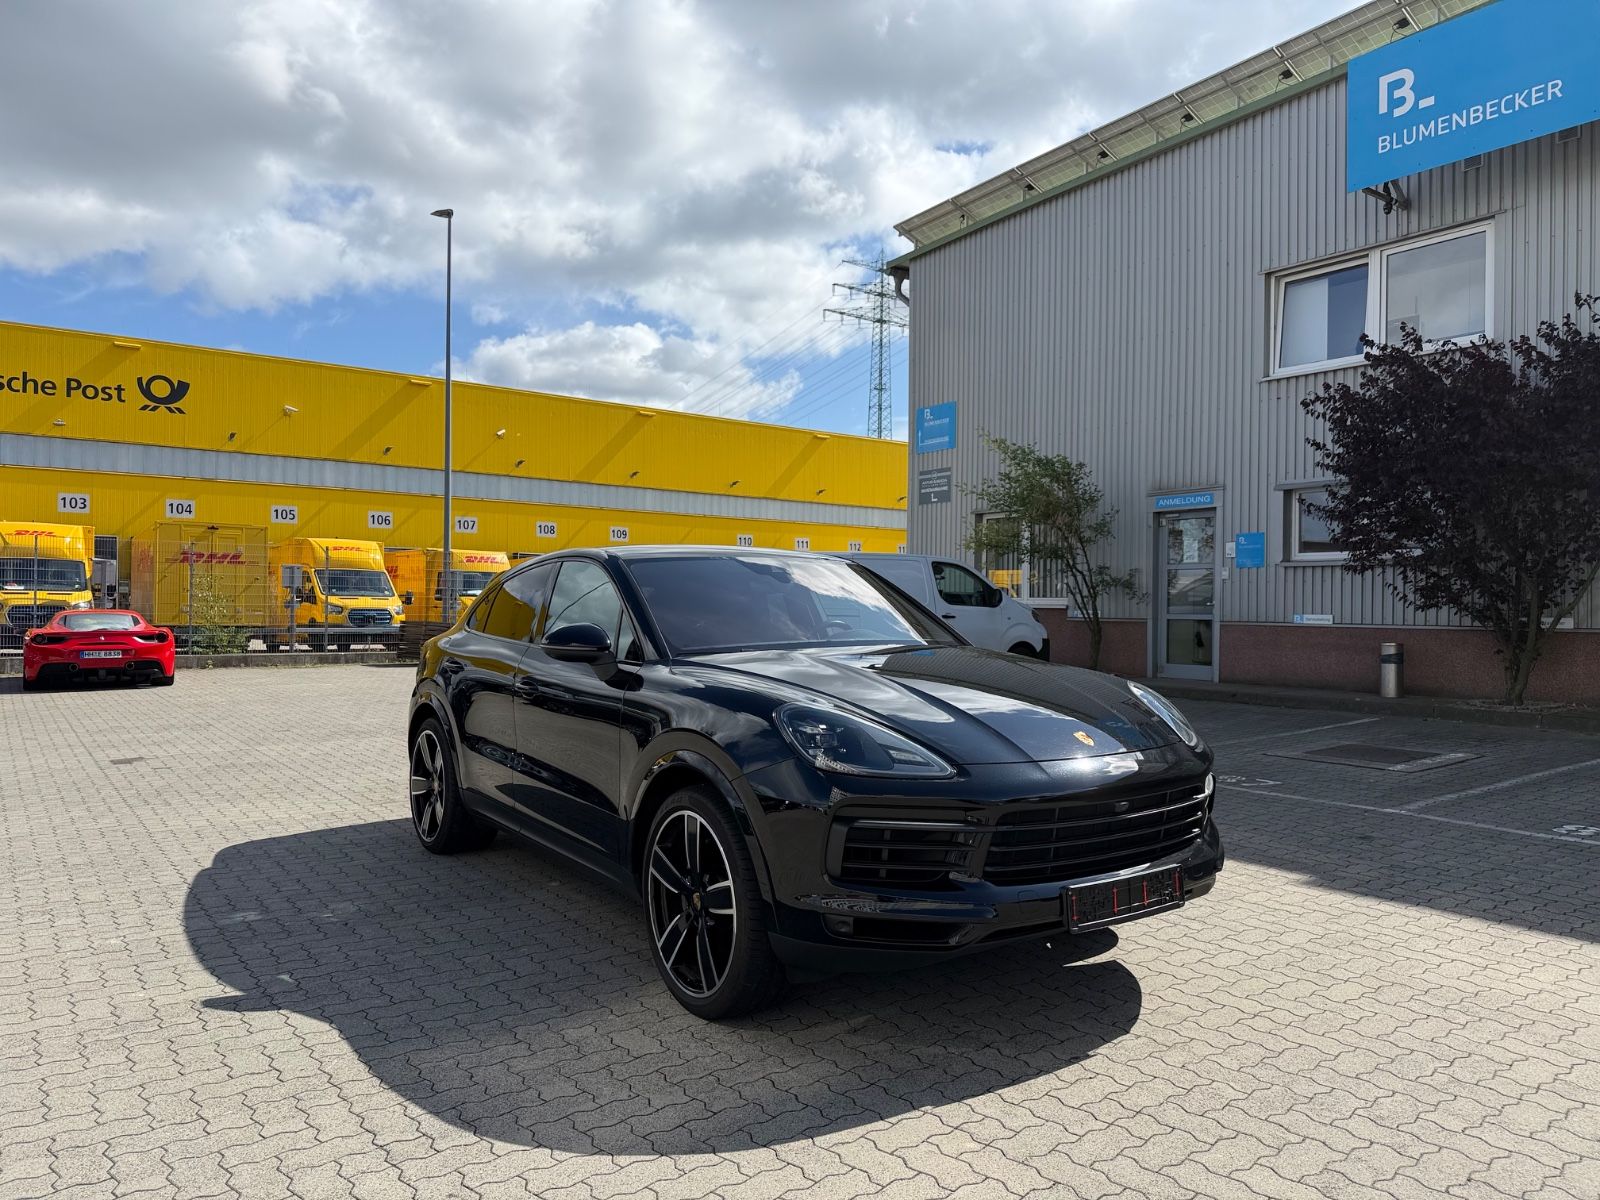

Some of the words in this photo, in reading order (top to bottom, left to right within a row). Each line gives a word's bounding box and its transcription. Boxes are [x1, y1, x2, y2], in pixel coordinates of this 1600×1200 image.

[1378, 79, 1563, 154] BLUMENBECKER
[66, 377, 126, 403] Post
[60, 497, 87, 509] 103
[1158, 495, 1211, 506] ANMELDUNG
[168, 503, 193, 515] 104
[273, 509, 296, 520] 105
[370, 515, 391, 526] 106
[457, 520, 475, 531] 107
[538, 525, 555, 535] 108
[612, 529, 628, 539] 109
[738, 537, 752, 546] 110
[796, 540, 809, 549] 111
[849, 543, 862, 552] 112
[180, 552, 245, 564] DHL
[464, 555, 502, 564] DHL
